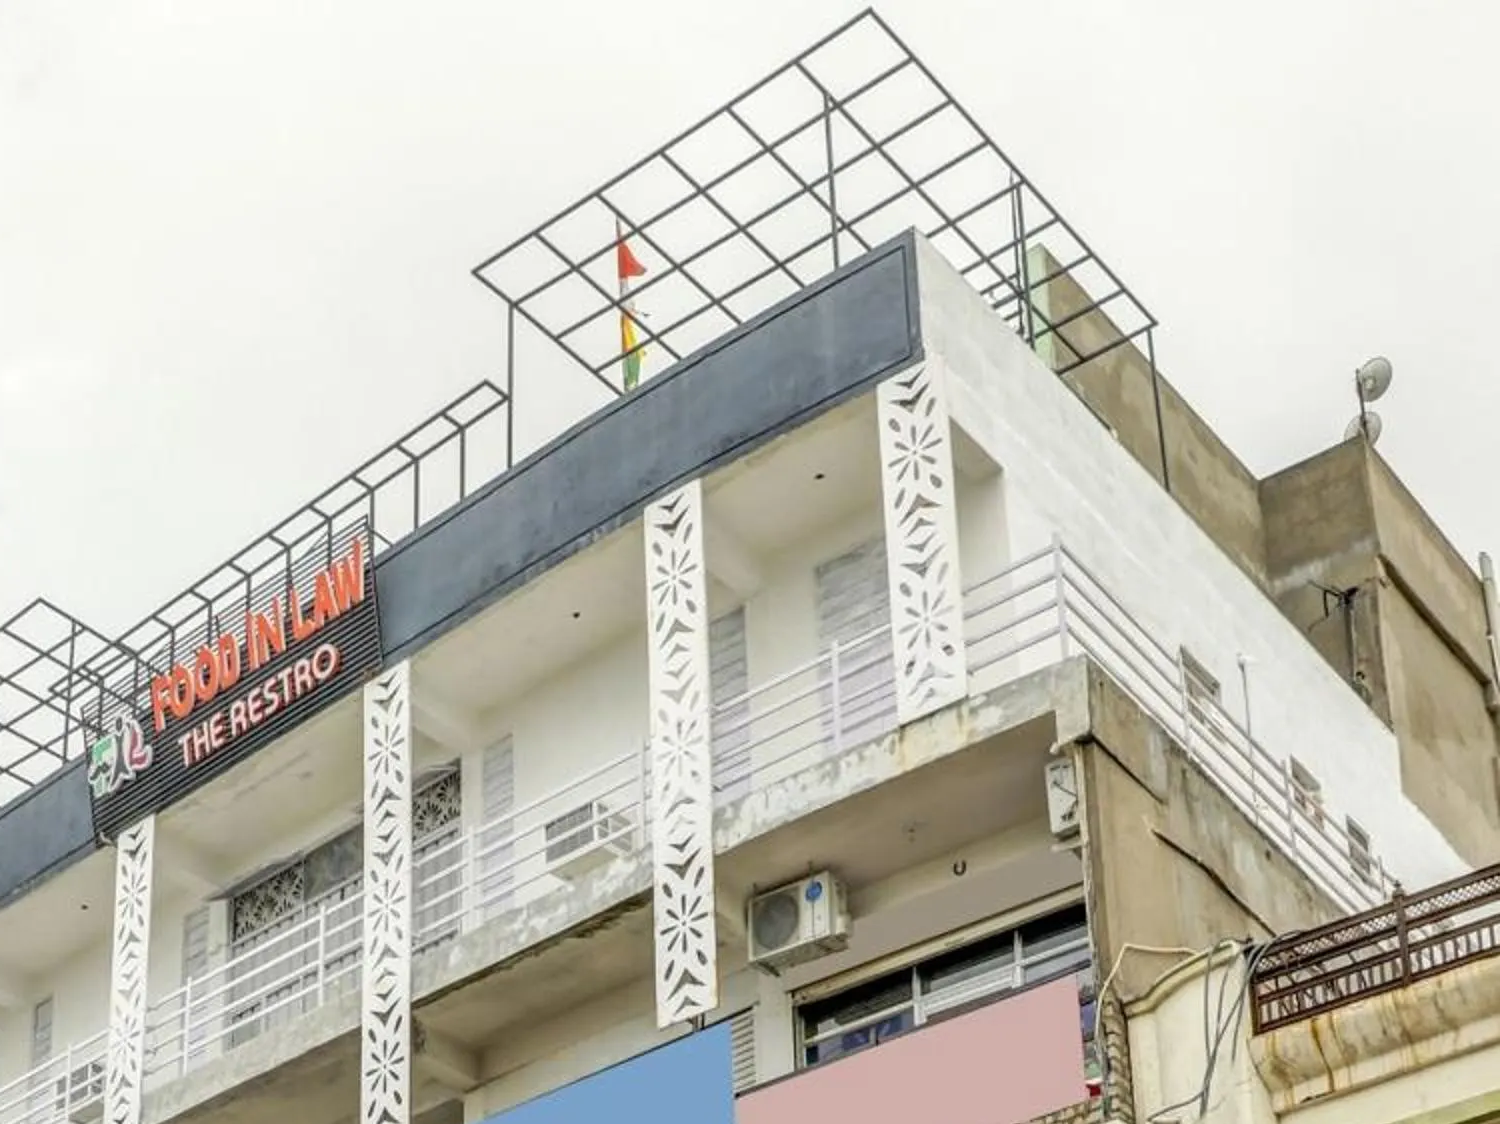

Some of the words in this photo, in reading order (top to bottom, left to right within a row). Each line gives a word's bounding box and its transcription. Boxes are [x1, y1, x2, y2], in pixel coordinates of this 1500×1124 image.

[150, 632, 241, 733] FOOD
[245, 594, 286, 672] IN
[286, 535, 365, 641] LAW
[179, 713, 226, 767] THE
[230, 643, 338, 736] RESTRO
